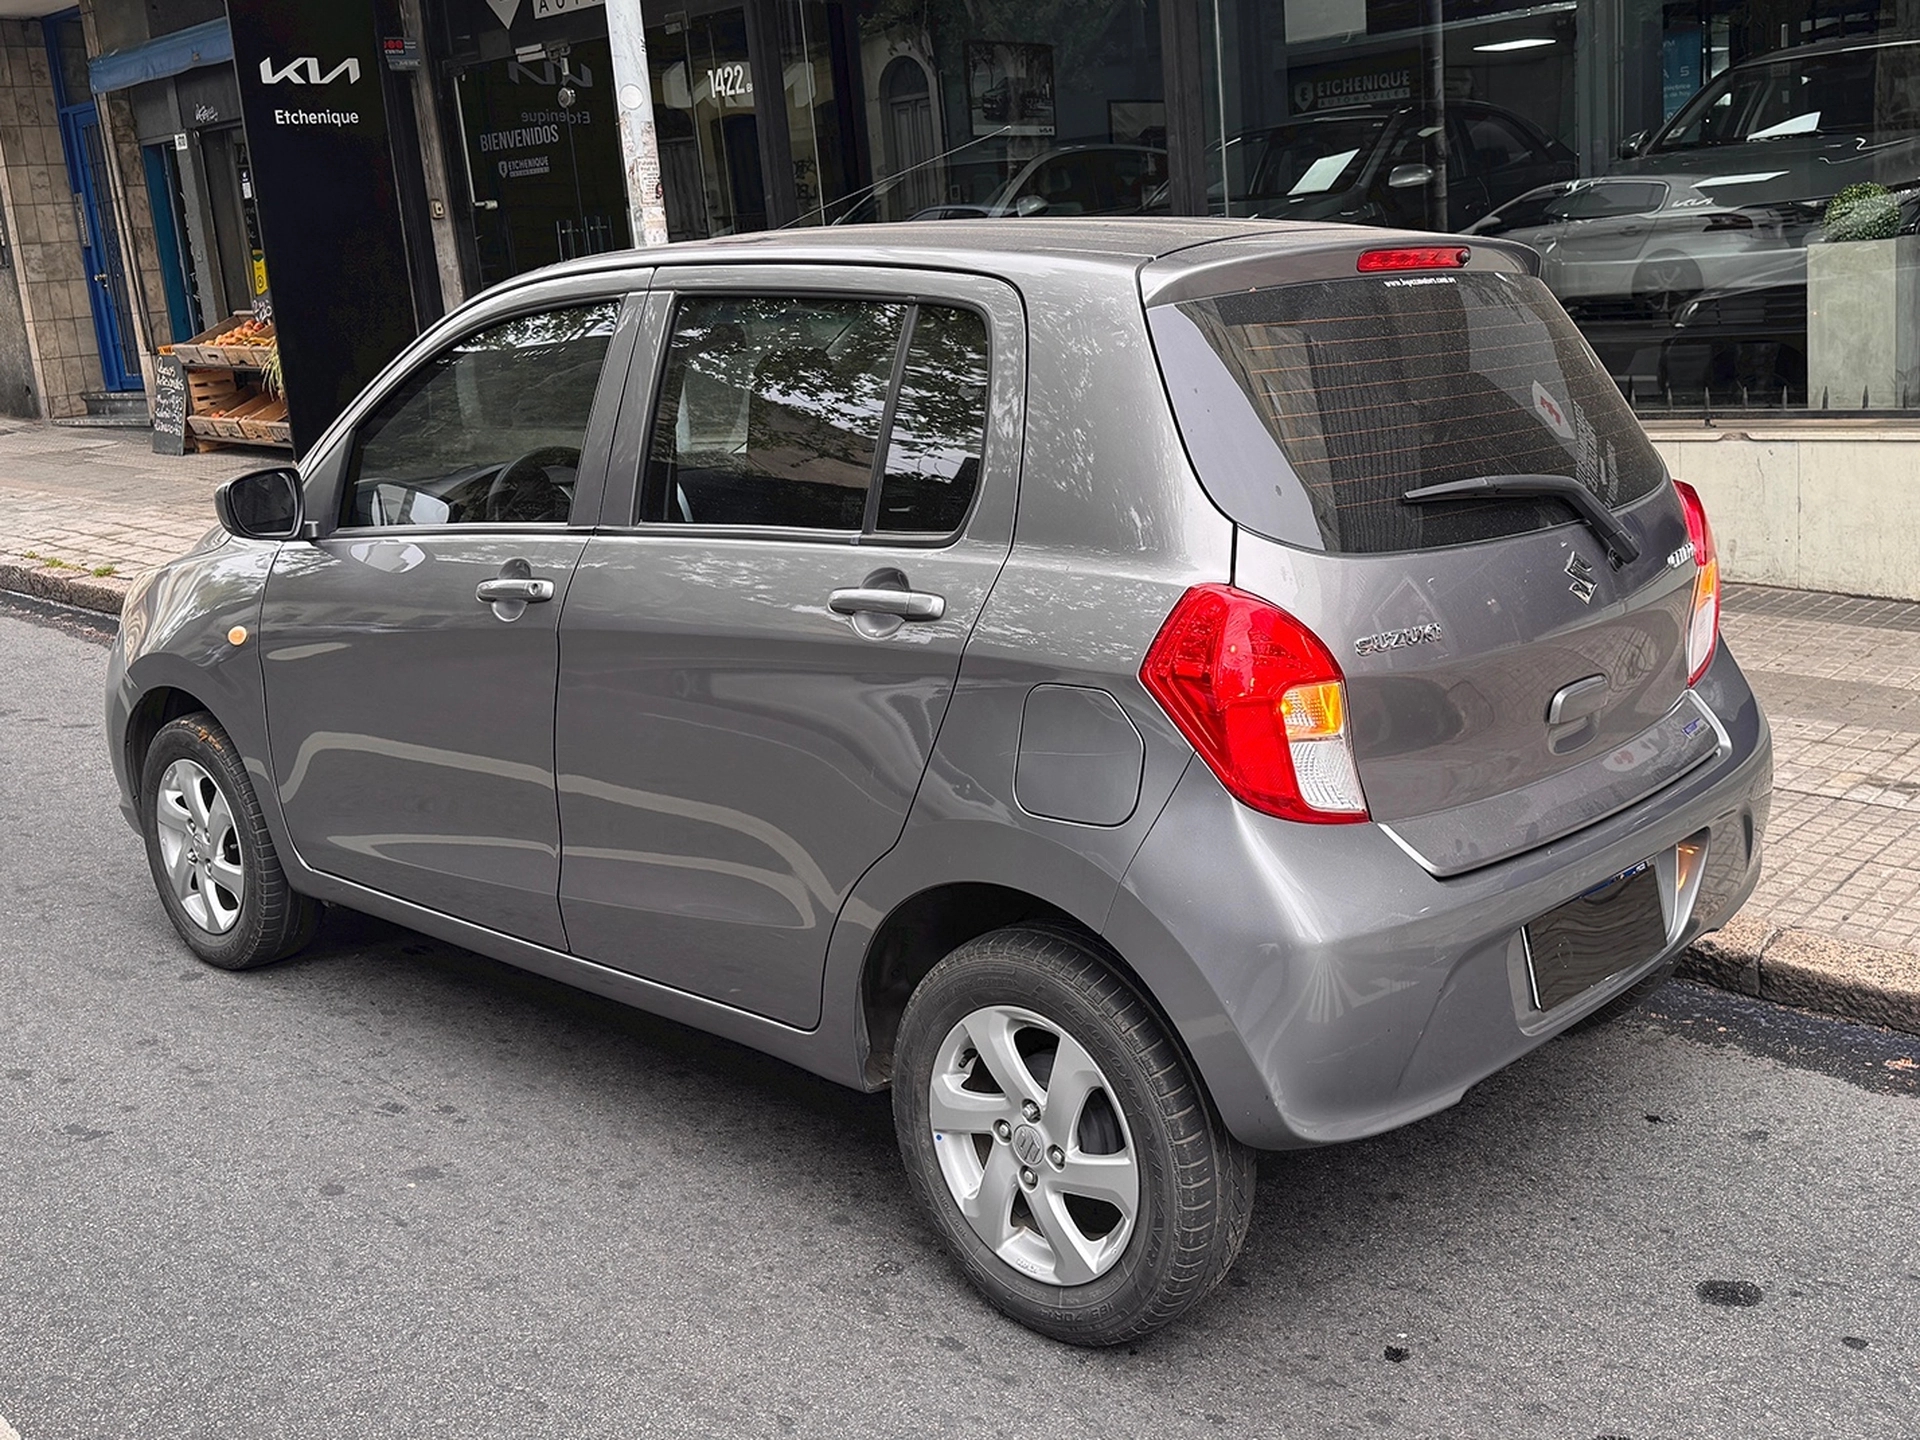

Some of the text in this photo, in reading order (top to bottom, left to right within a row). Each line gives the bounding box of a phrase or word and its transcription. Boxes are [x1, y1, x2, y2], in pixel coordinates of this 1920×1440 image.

[260, 57, 360, 84] KIA
[707, 64, 746, 98] 1422
[1317, 70, 1410, 97] ETCHENIQUE
[274, 109, 360, 127] Etchenique
[480, 123, 560, 152] BIENVENIDOS
[1353, 622, 1443, 657] SUZUKI
